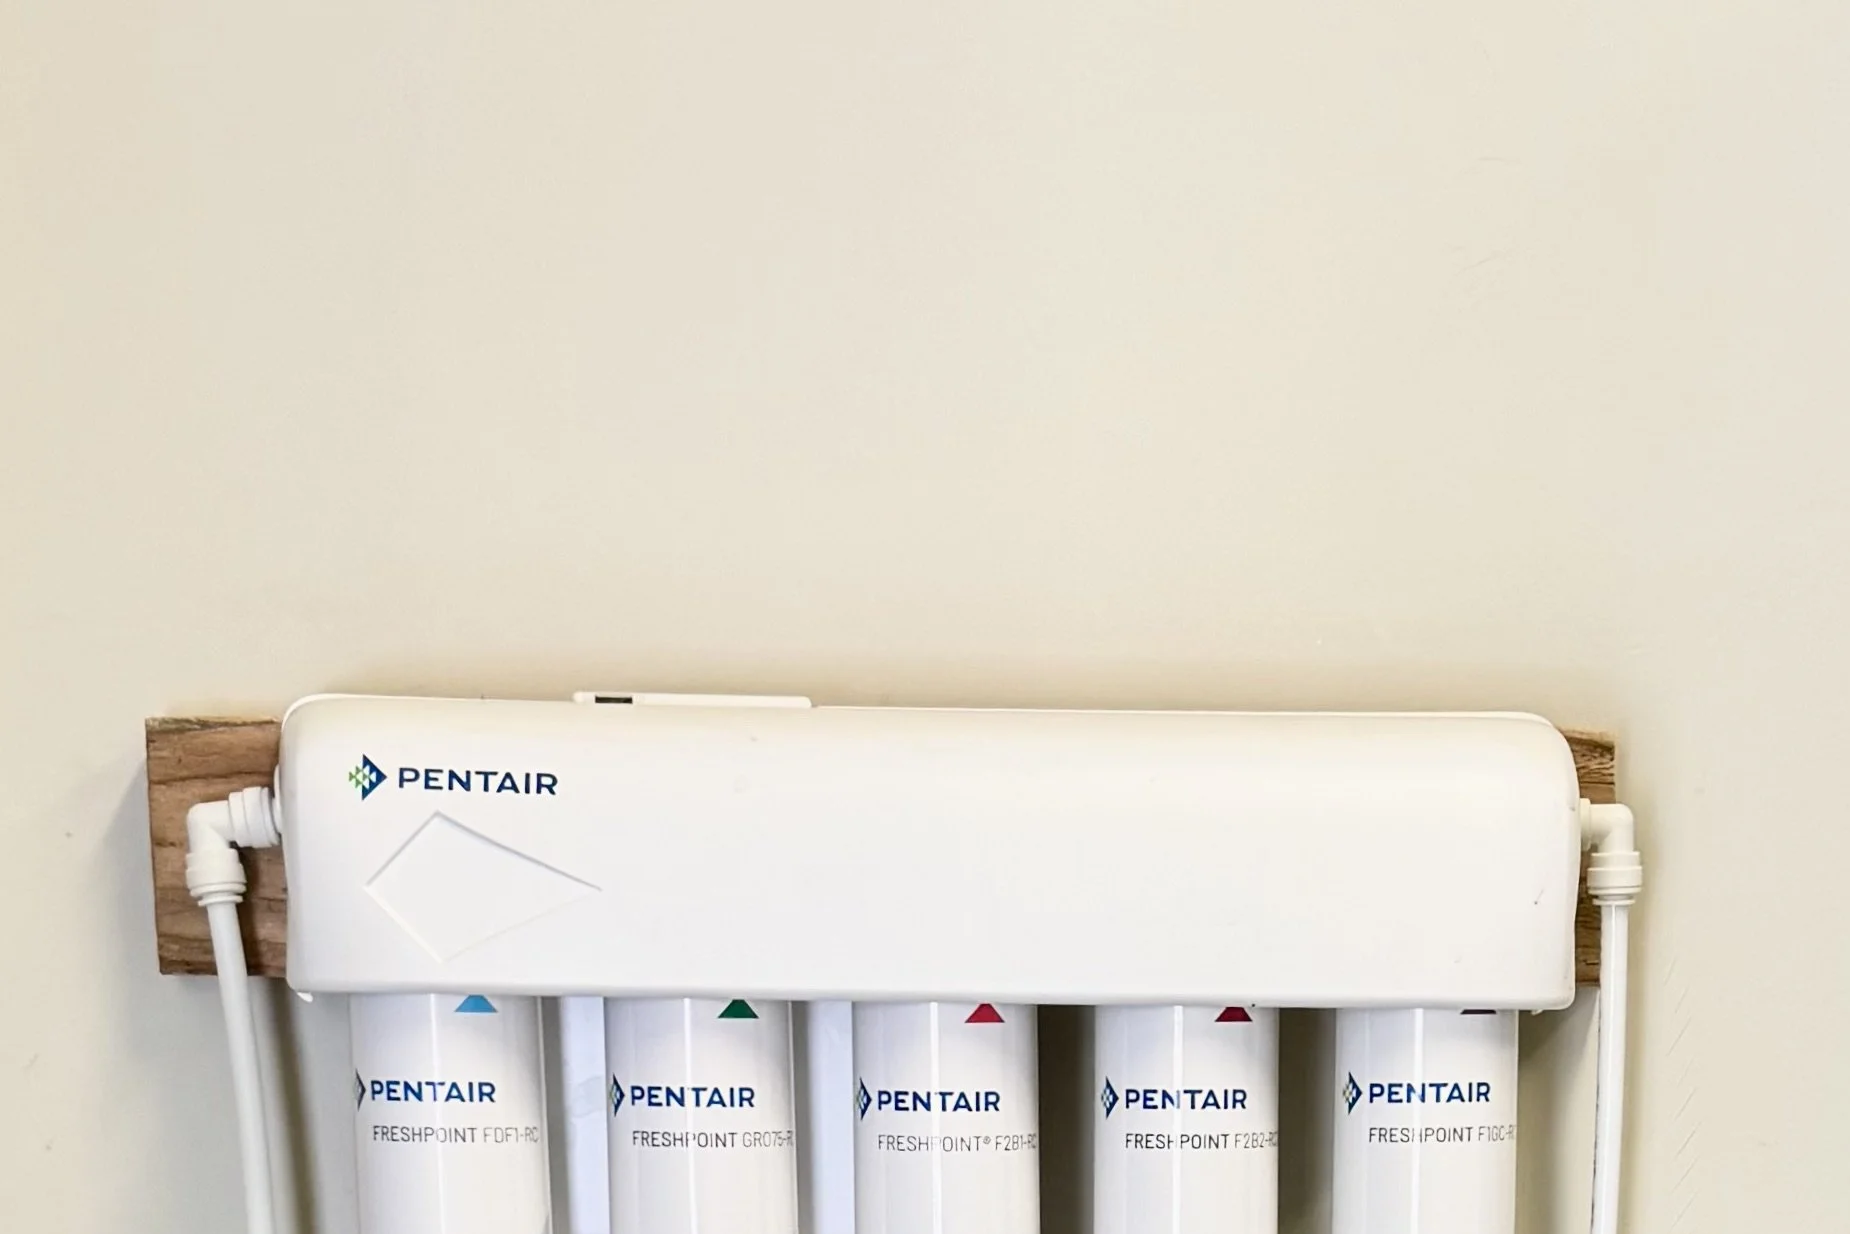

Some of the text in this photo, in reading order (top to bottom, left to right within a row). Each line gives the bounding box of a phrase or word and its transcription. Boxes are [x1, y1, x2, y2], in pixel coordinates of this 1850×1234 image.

[398, 767, 558, 795] PENTAIR
[370, 1080, 496, 1103] PENTAIR
[630, 1085, 755, 1108] PENTAIR
[877, 1090, 1001, 1112] PENTAIR
[1125, 1088, 1247, 1110] PENTAIR
[1369, 1082, 1490, 1104] PENTAIR
[373, 1125, 478, 1143] FRESHPOINT
[632, 1130, 737, 1148] FRESHPOINT
[1125, 1133, 1230, 1150] FRESHPOINT
[1368, 1127, 1474, 1143] FRESHPOINT
